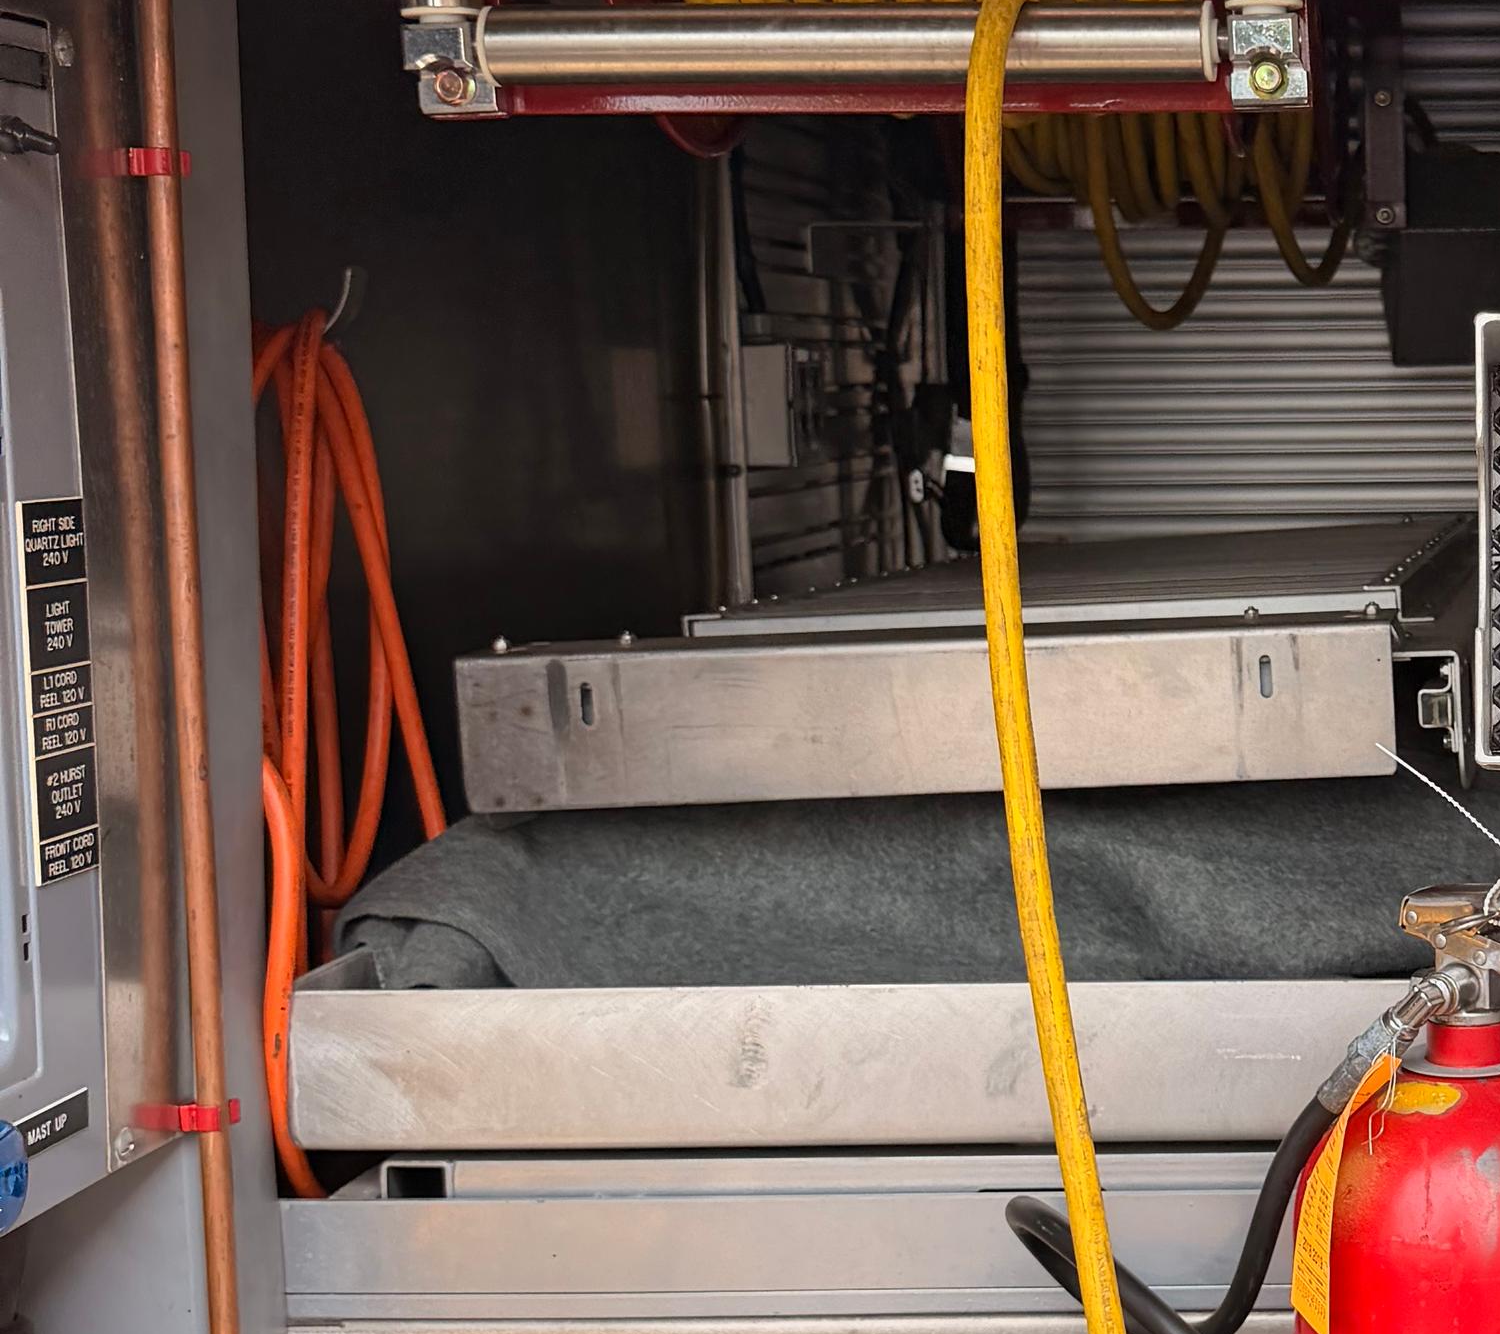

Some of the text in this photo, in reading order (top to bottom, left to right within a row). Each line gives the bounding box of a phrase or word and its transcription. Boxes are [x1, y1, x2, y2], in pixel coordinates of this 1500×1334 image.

[32, 516, 76, 533] RIGHT SIDE
[25, 532, 84, 553] QUARTZ LIGHT
[43, 550, 69, 567] 240 V
[46, 601, 70, 618] LIGHT
[45, 618, 74, 636] TOWER
[47, 634, 73, 652] 240 V
[54, 671, 77, 687] CORD
[40, 686, 85, 708] REEL 120 V
[57, 712, 79, 728] CORD
[42, 728, 86, 750] REEL 120 V
[60, 765, 86, 784] HURST
[51, 784, 83, 804] OUTLET
[55, 805, 73, 820] 240
[44, 833, 95, 860] FRONT CORD
[48, 860, 69, 877] REEL
[71, 854, 85, 869] 120
[27, 1113, 67, 1145] MAST UP
